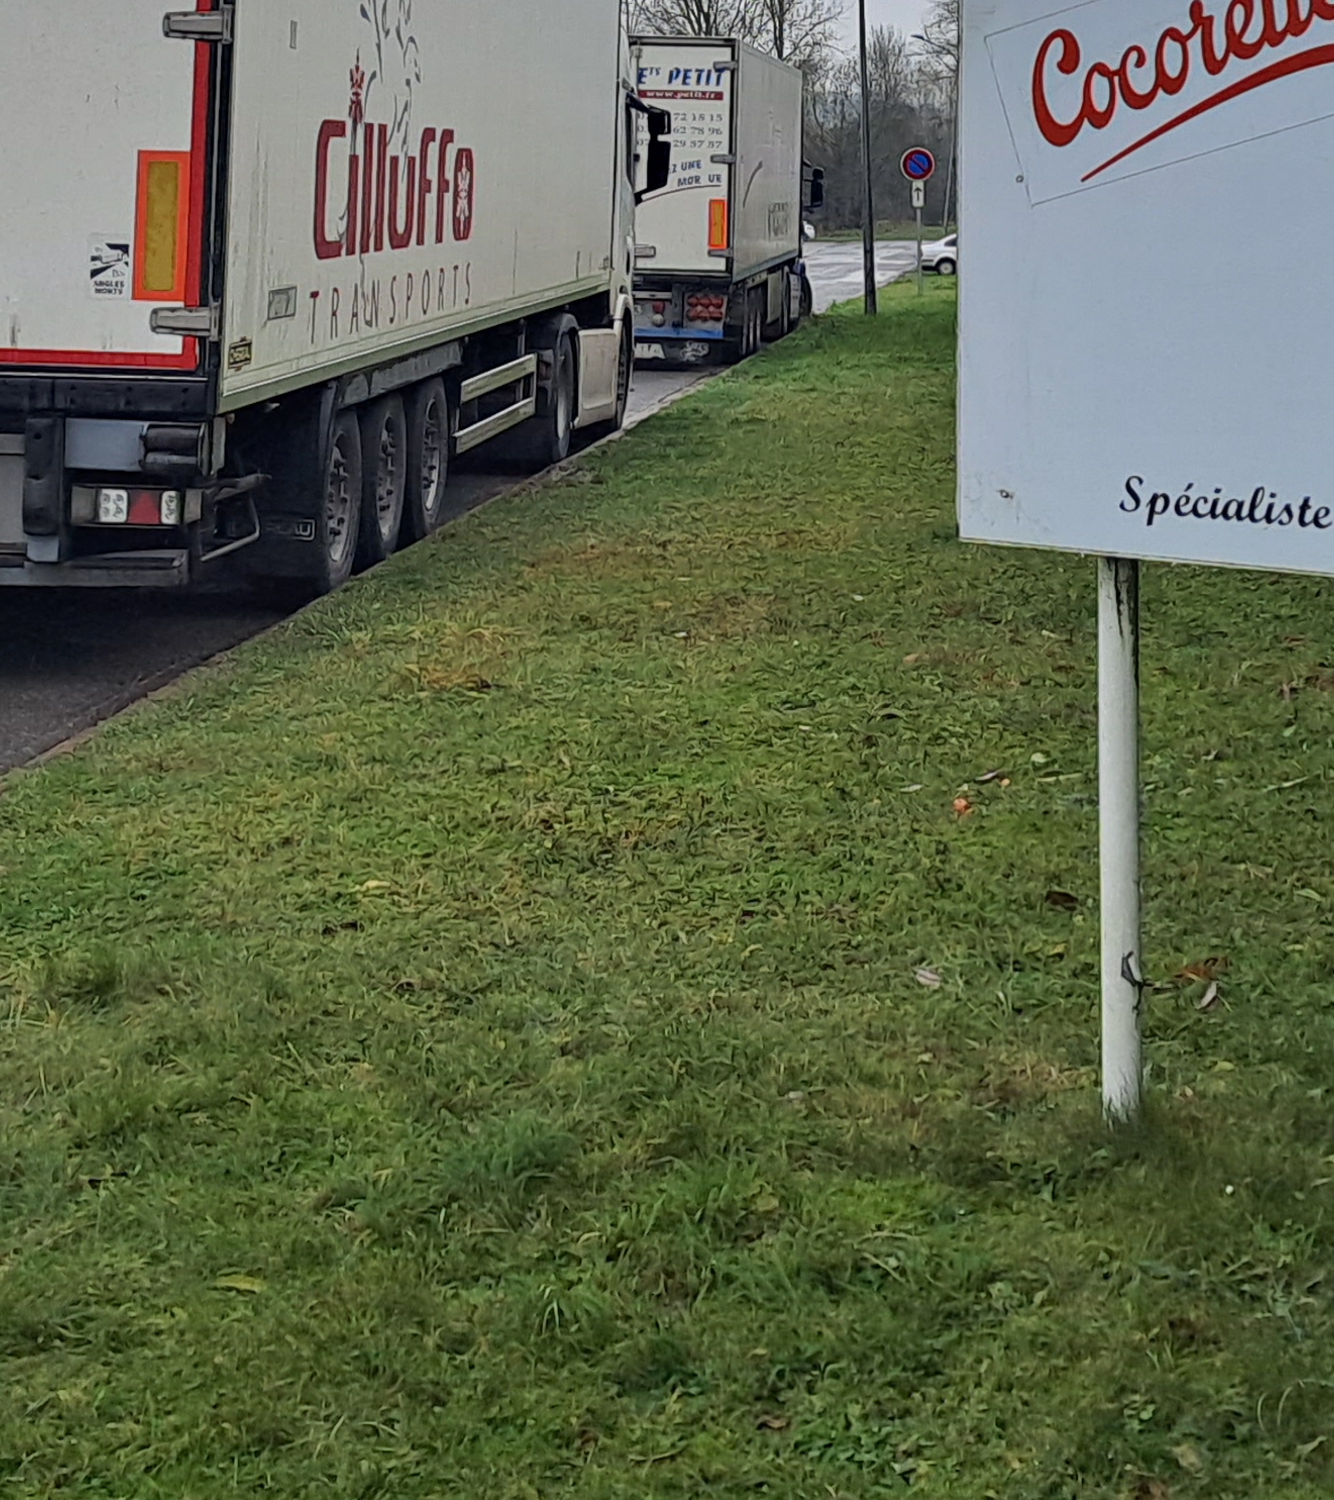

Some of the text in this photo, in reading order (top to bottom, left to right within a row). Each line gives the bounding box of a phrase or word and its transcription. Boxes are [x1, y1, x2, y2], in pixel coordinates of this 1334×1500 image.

[668, 66, 726, 87] PETIT
[308, 263, 472, 345] TRANSPORTS
[1120, 475, 1333, 527] Spécialiste
